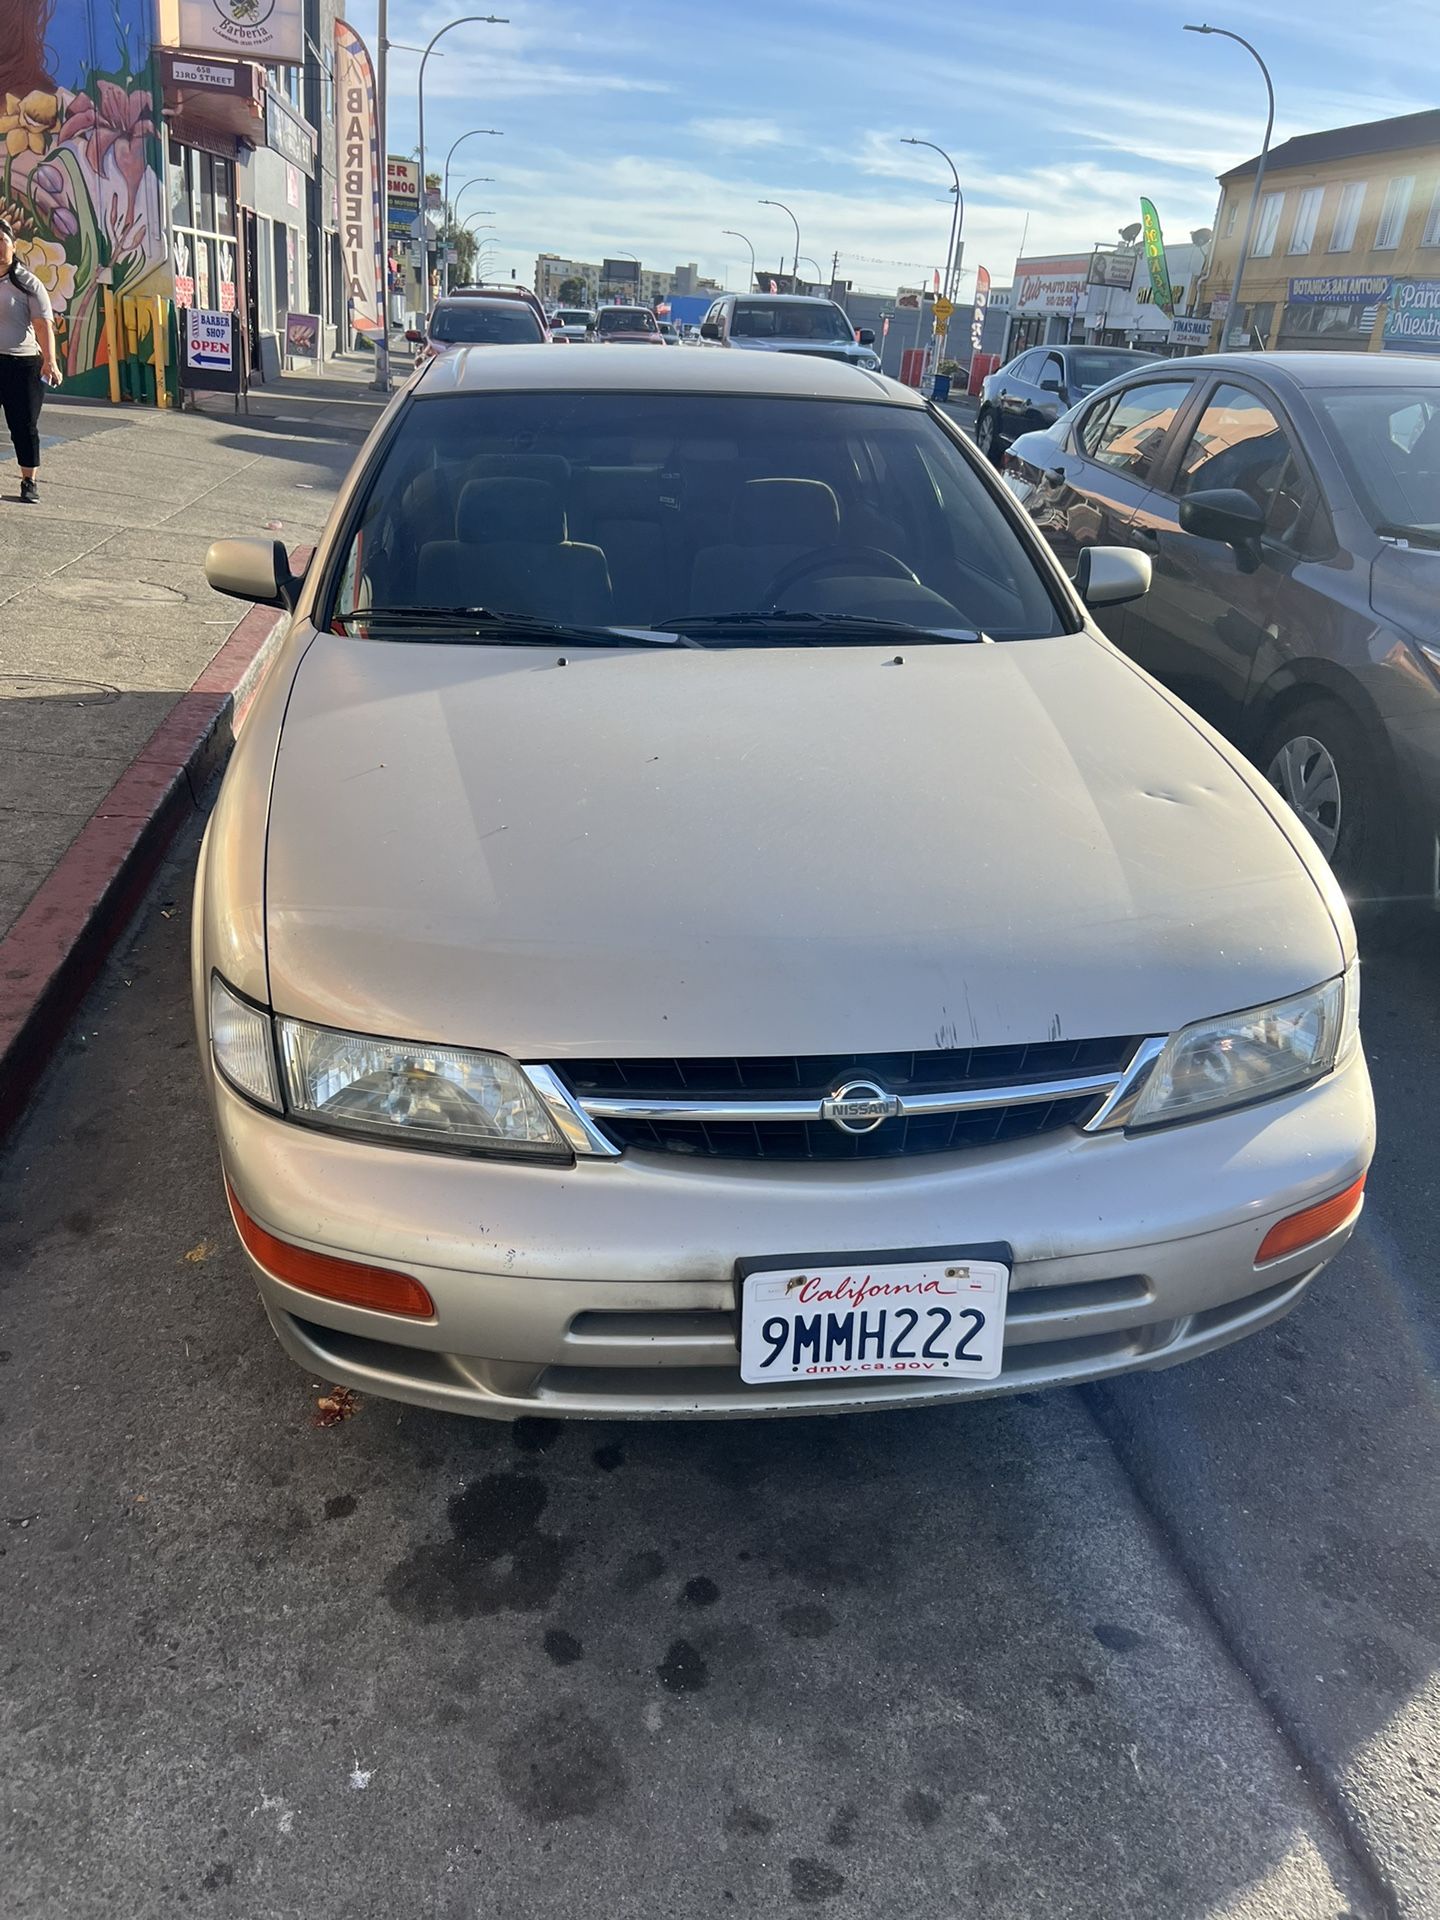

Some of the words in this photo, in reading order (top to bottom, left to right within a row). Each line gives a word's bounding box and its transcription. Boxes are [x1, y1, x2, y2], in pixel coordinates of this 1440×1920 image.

[196, 65, 211, 73] 658
[175, 71, 197, 80] 23RD
[199, 74, 232, 85] STREET
[387, 180, 415, 194] SMOG
[1046, 281, 1065, 293] AUTO
[1292, 279, 1330, 295] BOTANICA
[1330, 279, 1349, 295] SAN
[1349, 278, 1387, 295] ANTONIO
[200, 314, 230, 327] BARBER
[206, 326, 225, 339] SHOP
[190, 339, 229, 354] OPEN
[832, 1102, 889, 1116] NISSAN
[799, 1273, 957, 1307] California
[760, 1307, 986, 1368] 9MMH222
[806, 1361, 935, 1374] dmv.ca.gov
